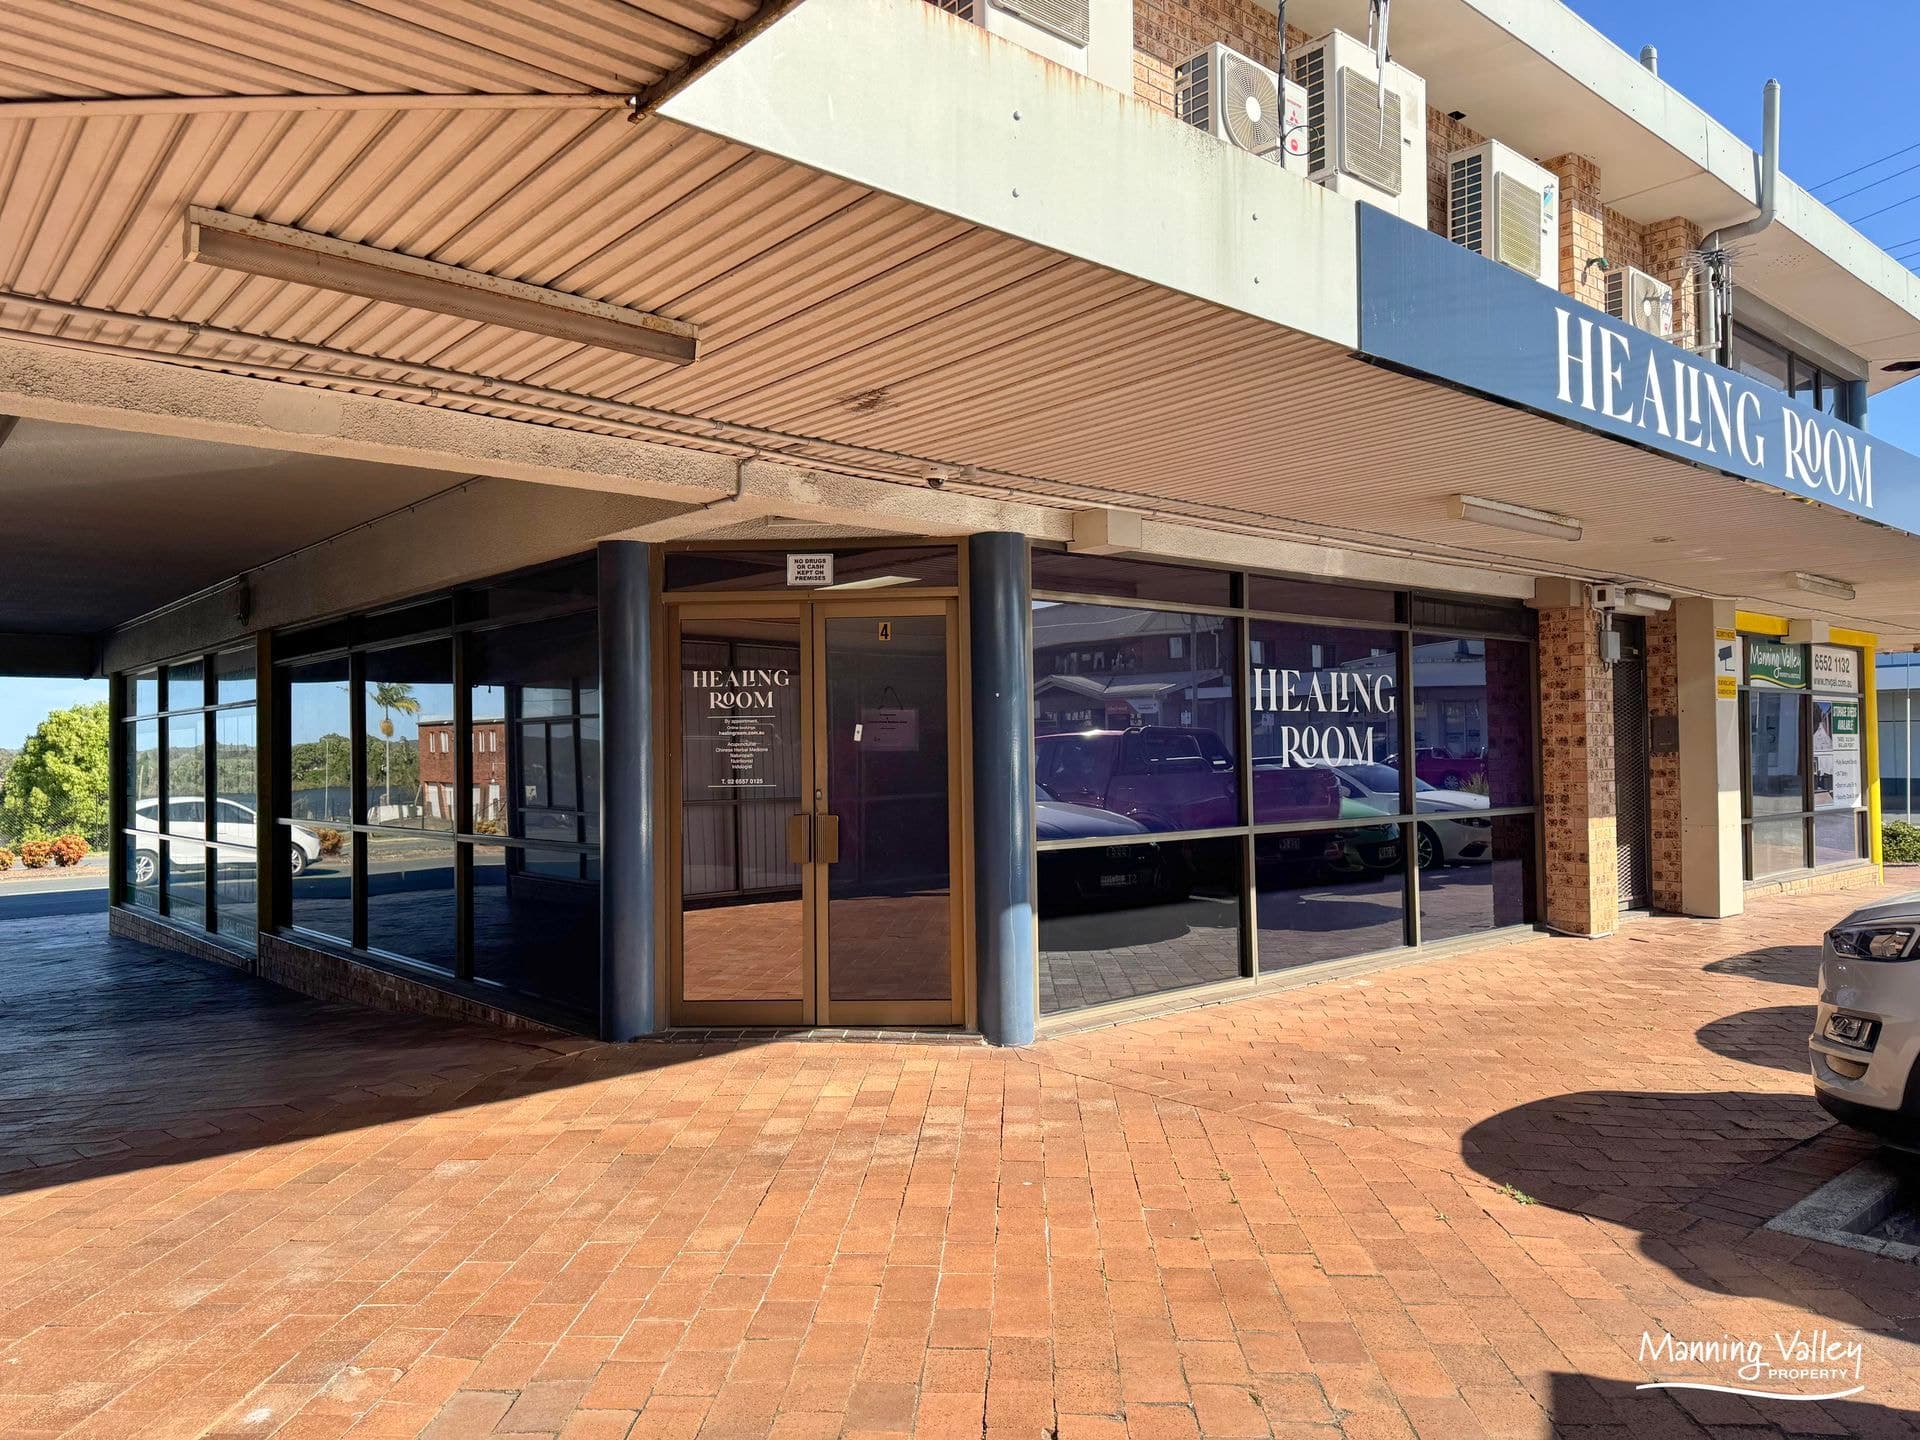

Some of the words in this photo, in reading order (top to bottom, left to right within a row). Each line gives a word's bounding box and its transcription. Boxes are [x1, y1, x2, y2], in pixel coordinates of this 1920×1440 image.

[1554, 306, 1765, 469] HEALING
[1781, 406, 1874, 509] ROOM
[880, 624, 889, 640] 4
[1750, 643, 1781, 678] Manning
[1781, 647, 1802, 680] Valley
[1814, 654, 1833, 672] 6552
[1834, 656, 1850, 673] 1132
[693, 669, 790, 688] HEALING
[1253, 668, 1395, 714] HEALING
[709, 691, 774, 709] ROOM
[1280, 725, 1375, 768] ROOM
